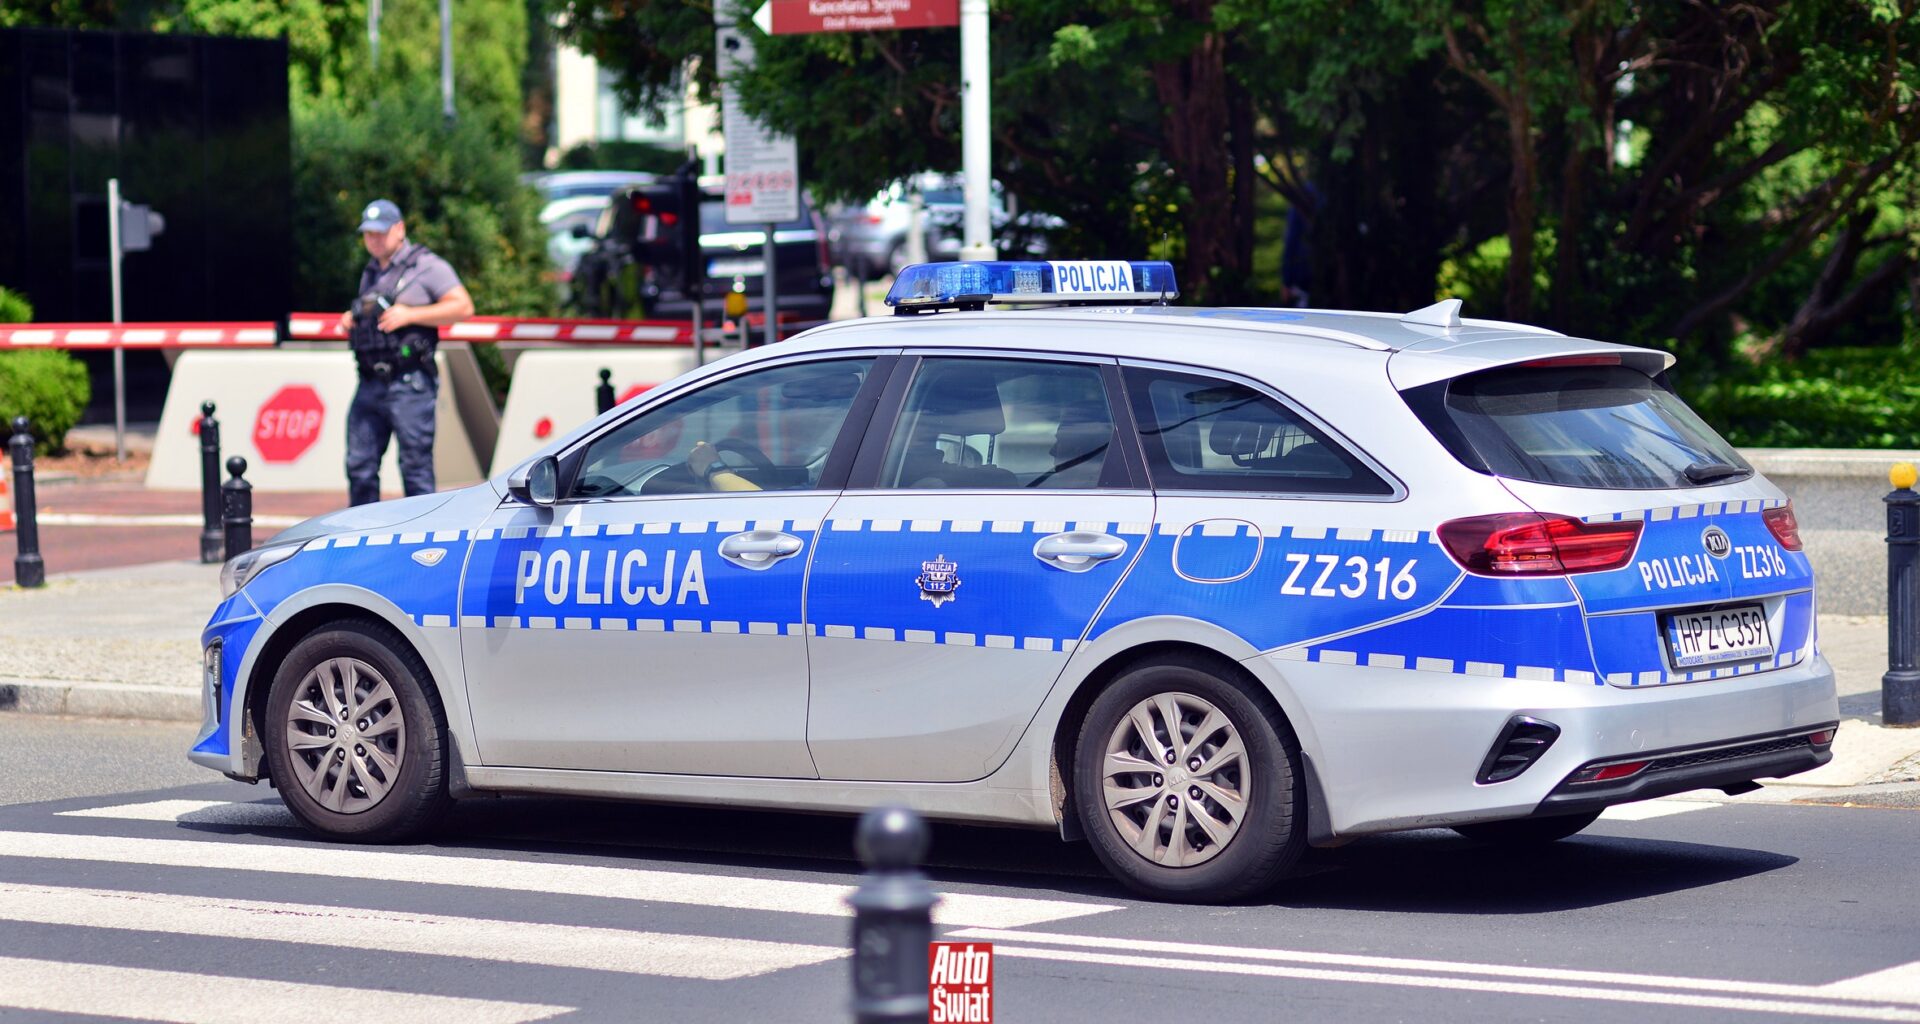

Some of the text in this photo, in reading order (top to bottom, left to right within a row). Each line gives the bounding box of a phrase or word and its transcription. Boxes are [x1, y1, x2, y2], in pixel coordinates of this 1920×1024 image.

[1058, 264, 1130, 293] POLICJA
[258, 408, 321, 440] STOP
[1707, 534, 1729, 551] KIA
[515, 548, 710, 606] POLICJA
[926, 563, 952, 572] POLICJA
[1280, 552, 1418, 601] ZZ316
[1637, 544, 1787, 592] POLICJA ZZ316
[930, 582, 946, 590] 112
